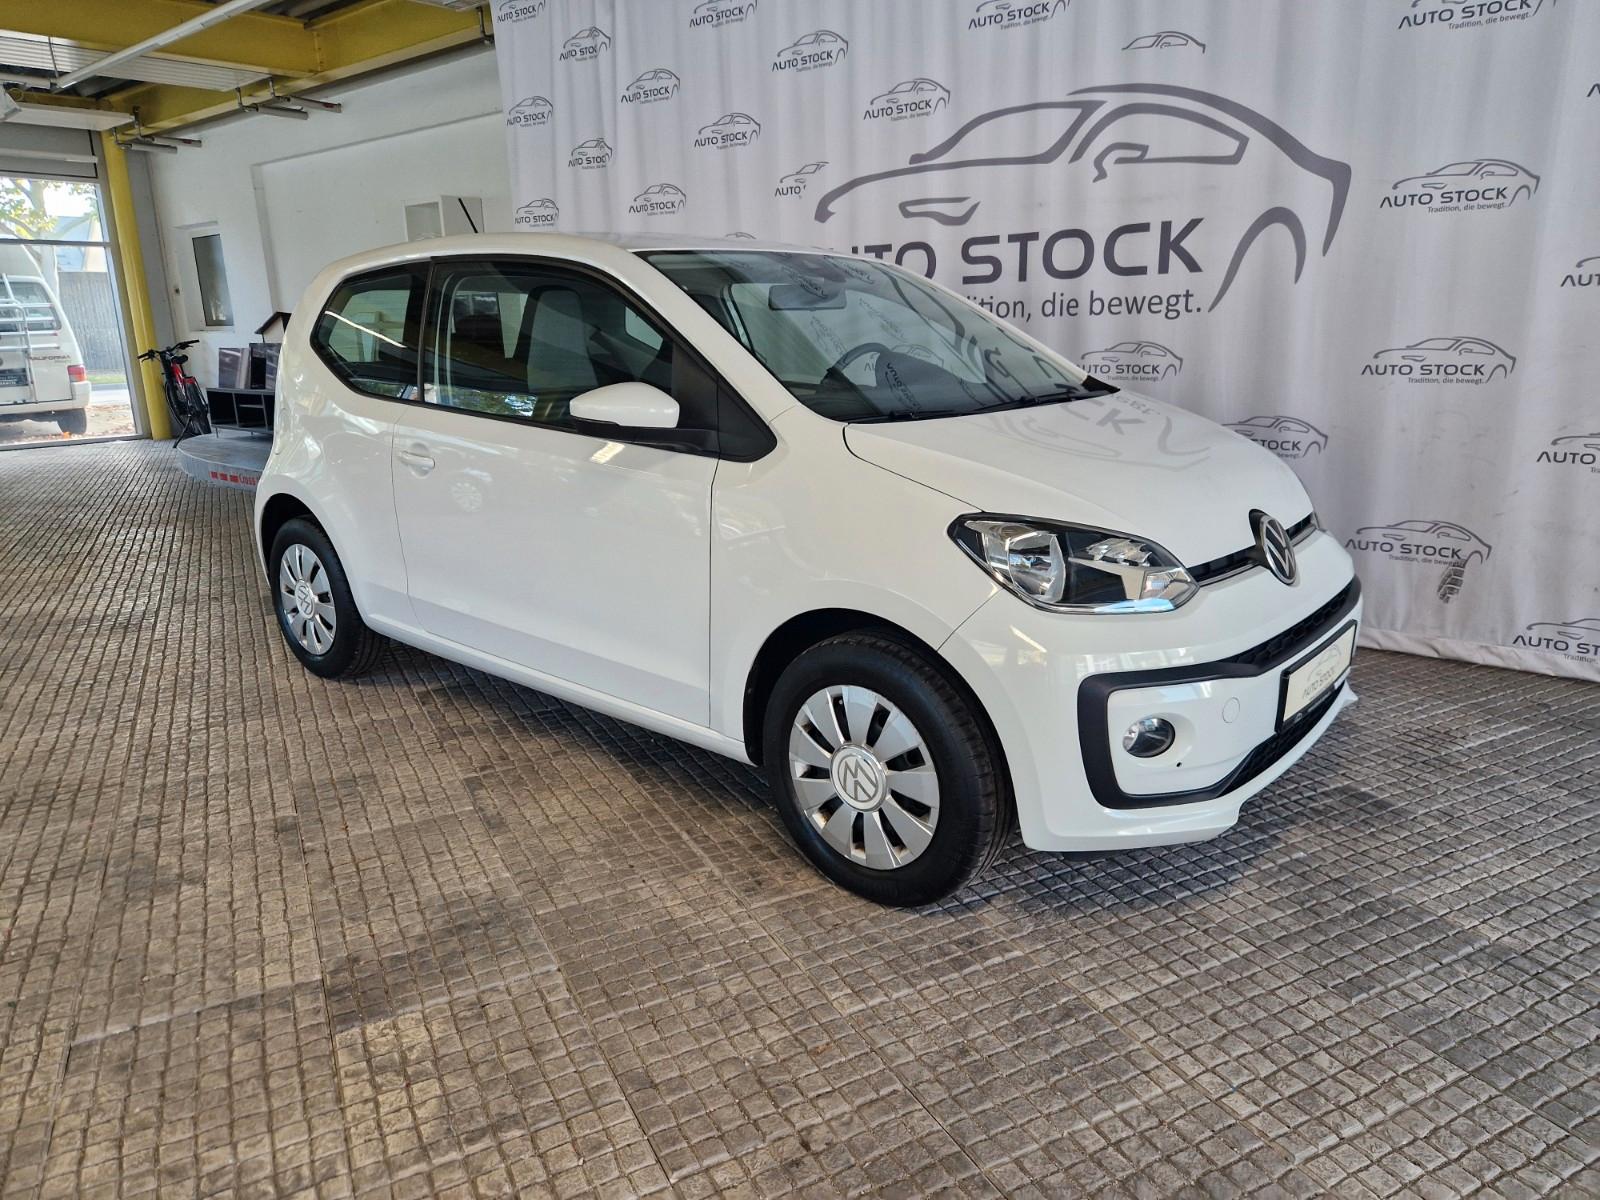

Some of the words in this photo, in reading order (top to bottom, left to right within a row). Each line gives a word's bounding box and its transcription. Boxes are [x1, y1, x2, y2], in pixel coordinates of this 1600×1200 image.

[690, 15, 713, 28] AUTO
[716, 6, 744, 21] STOCK
[969, 13, 1003, 30] AUTO
[1008, 2, 1050, 21] STOCK
[1398, 9, 1454, 29] AUTO
[1462, 0, 1531, 19] STOCK
[1449, 20, 1483, 30] Tradition,
[772, 58, 798, 72] AUTO
[801, 50, 833, 65] STOCK
[643, 86, 670, 98] STOCK
[864, 107, 893, 120] AUTO
[897, 99, 932, 114] STOCK
[695, 137, 718, 147] AUTO
[721, 131, 747, 144] STOCK
[774, 186, 801, 197] AUTO
[1380, 194, 1433, 208] AUTO
[1440, 187, 1508, 204] STOCK
[629, 204, 648, 213] AUTO
[650, 201, 676, 210] STOCK
[852, 242, 936, 279] TO
[961, 218, 1205, 285] STOCK
[1041, 295, 1079, 318] die
[1089, 290, 1202, 320] bewegt.
[1077, 365, 1111, 374] UTO
[1116, 364, 1160, 374] STOCK
[1361, 364, 1413, 376] AUTO
[1420, 364, 1486, 376] STOCK
[1250, 439, 1301, 452] TOCK
[1536, 451, 1596, 464] AUTO
[1344, 538, 1394, 552] AUTO
[1400, 544, 1462, 559] STOCK
[1512, 635, 1569, 651] AUTO
